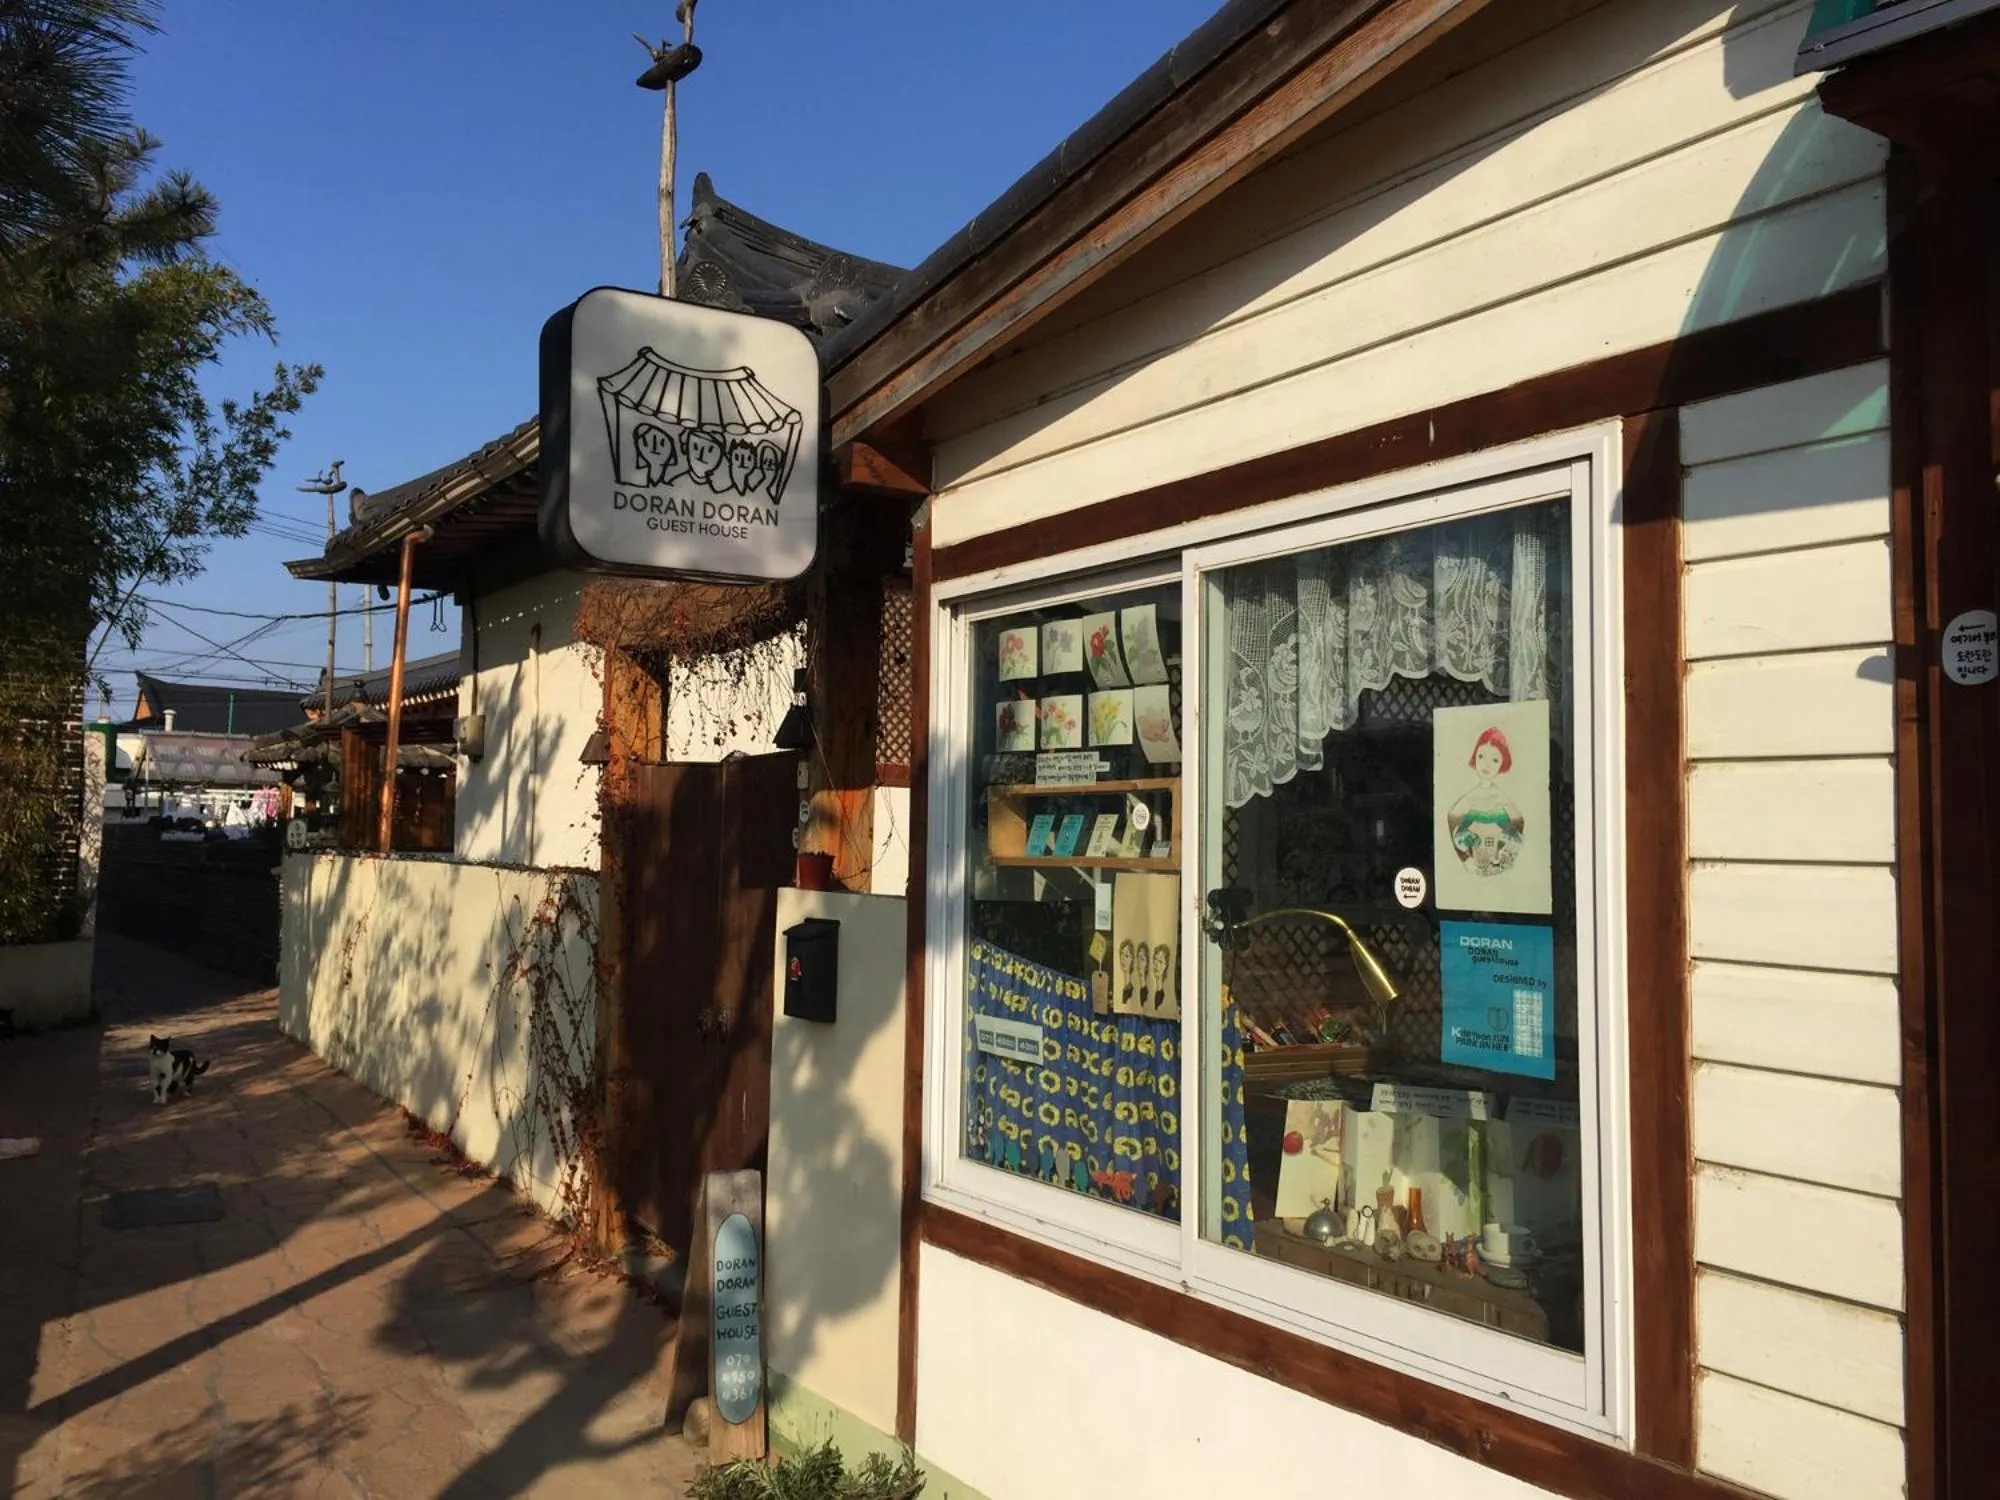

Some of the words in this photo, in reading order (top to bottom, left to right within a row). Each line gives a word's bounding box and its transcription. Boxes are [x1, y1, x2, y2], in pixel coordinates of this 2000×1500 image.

[613, 491, 695, 518] DORAN
[703, 502, 780, 527] DORAN
[646, 517, 694, 533] GUEST
[699, 523, 748, 539] HOUSE
[1459, 936, 1513, 951] DORAN
[717, 1258, 756, 1271] DORAN
[717, 1278, 756, 1292] DORAN
[716, 1303, 757, 1320] GUEST
[717, 1325, 758, 1340] HOUSE
[726, 1354, 750, 1369] 070
